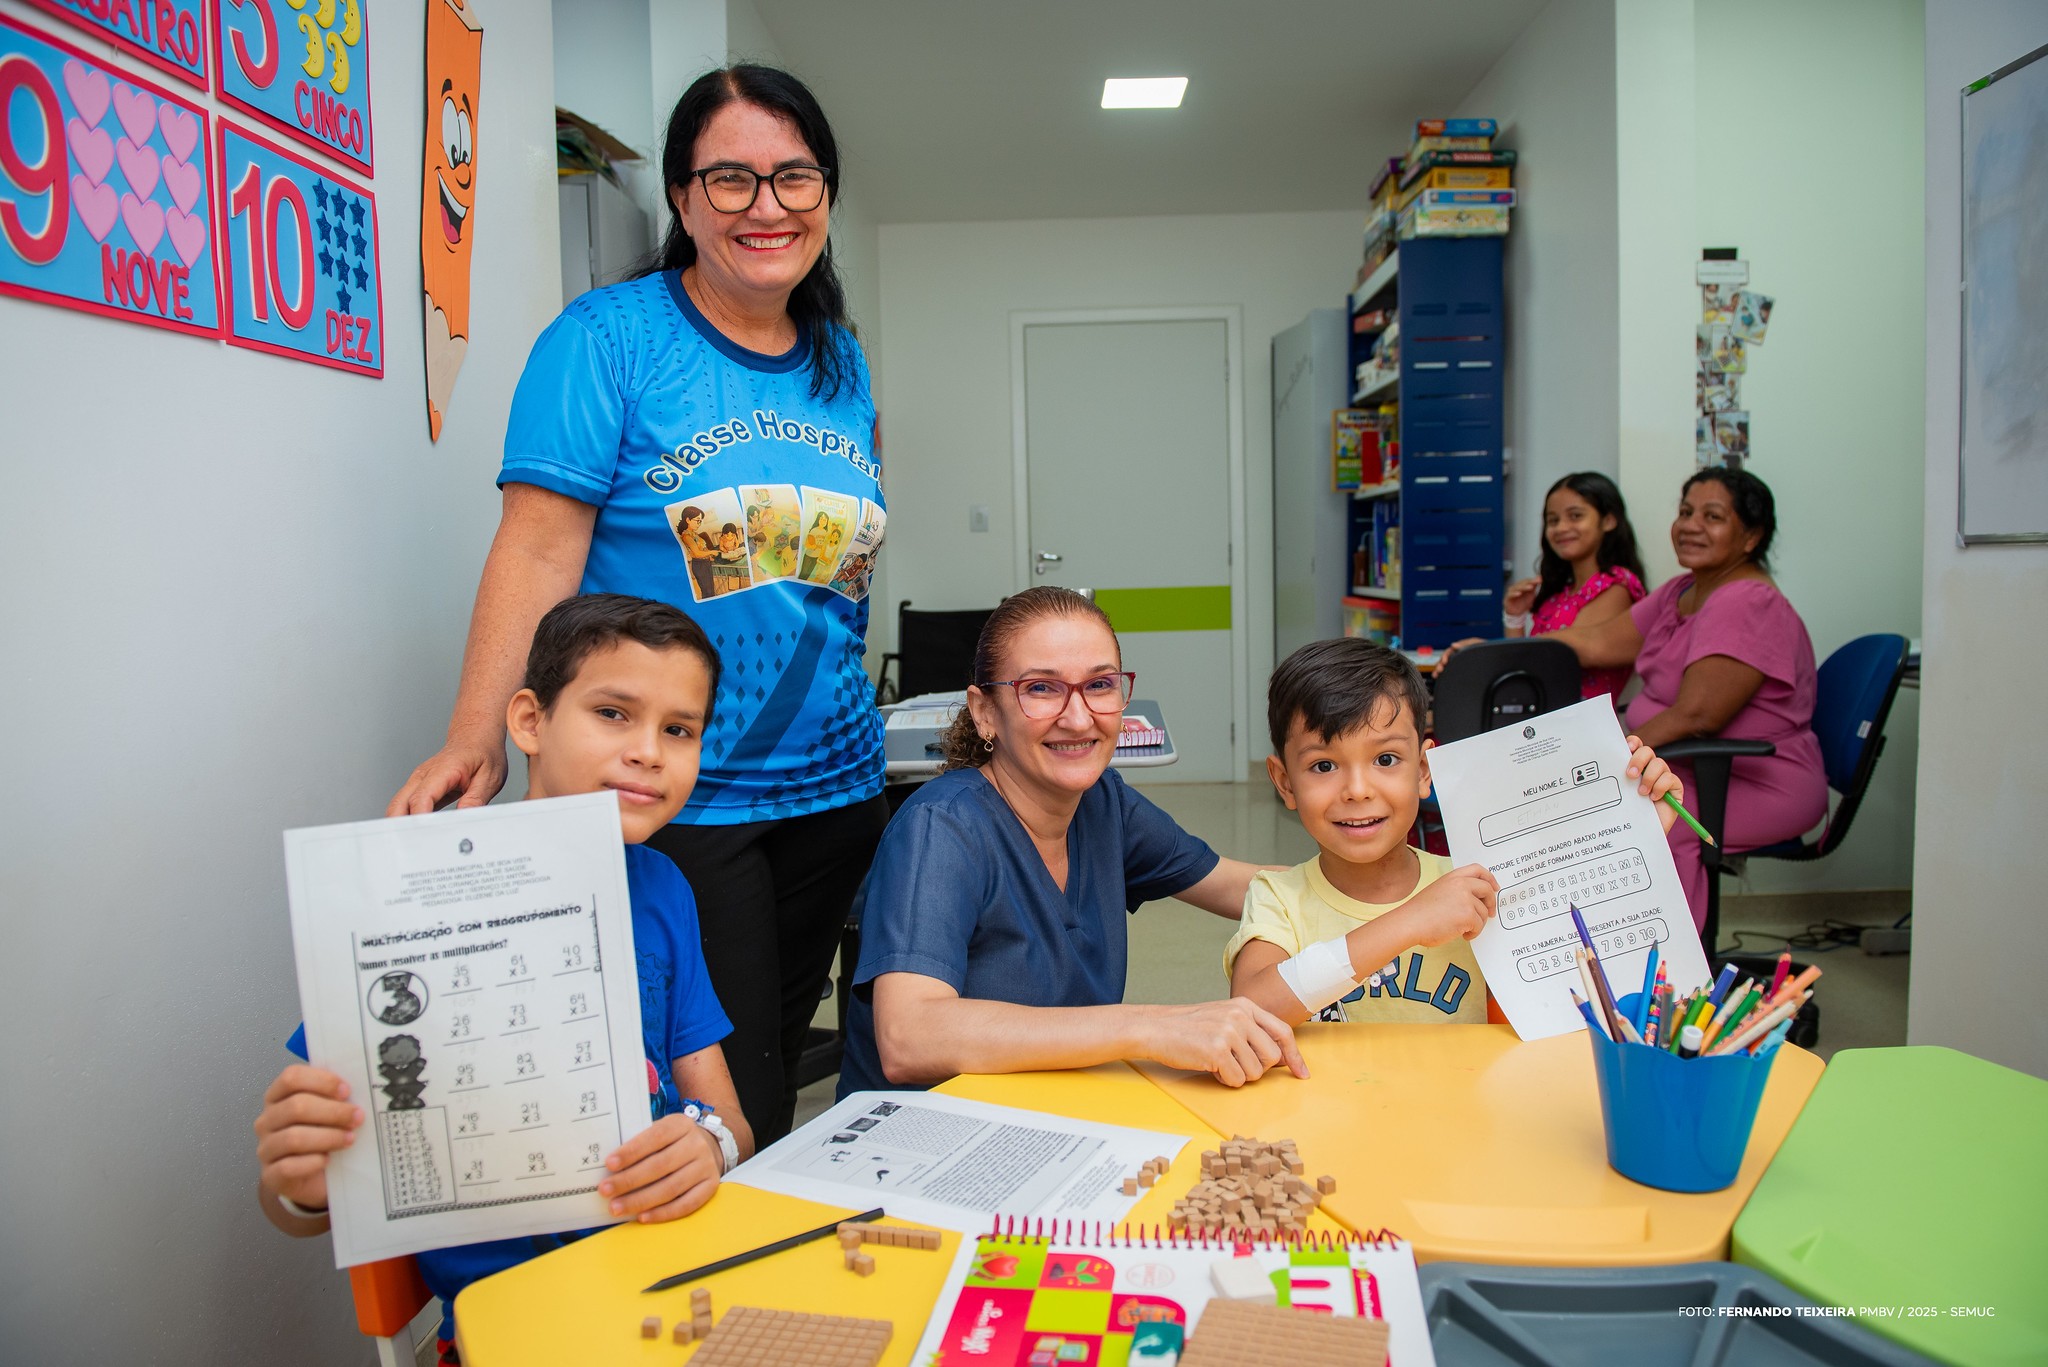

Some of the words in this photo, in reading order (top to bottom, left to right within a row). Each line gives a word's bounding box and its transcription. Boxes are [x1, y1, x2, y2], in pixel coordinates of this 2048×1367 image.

[294, 80, 364, 154] CINCO
[0, 53, 70, 266] 9
[231, 161, 315, 331] 10
[101, 243, 194, 321] NOVE
[325, 309, 374, 363] DEZ
[644, 418, 751, 493] Classe
[1522, 788, 1538, 798] MEU
[1539, 782, 1558, 794] NOME
[1488, 859, 1516, 873] PROCURE
[1520, 853, 1538, 864] PINTE
[1548, 840, 1572, 853] QUADRO
[1573, 833, 1597, 845] ABAIXO
[1598, 826, 1622, 838] APENAS
[1623, 822, 1632, 830] AS
[1513, 867, 1535, 879] LETRAS
[1536, 862, 1546, 871] QUE
[1548, 855, 1574, 866] FORMAM
[1582, 848, 1594, 856] SEU
[1500, 898, 1507, 907] A
[1510, 894, 1516, 903] B
[1519, 891, 1526, 900] C
[1529, 887, 1536, 897] D
[1538, 884, 1546, 894] E
[1548, 881, 1554, 891] F
[1557, 878, 1566, 887] G
[1568, 874, 1577, 885] H
[1579, 872, 1587, 882] I
[1589, 869, 1596, 879] J
[1598, 866, 1607, 876] K
[1609, 864, 1616, 873] L
[1619, 859, 1631, 870] M
[1633, 856, 1643, 866] N
[1507, 911, 1515, 920] O
[1518, 908, 1525, 917] P
[1528, 904, 1537, 915] Q
[1541, 901, 1549, 911] R
[1551, 898, 1558, 907] S
[1560, 895, 1568, 904] T
[1570, 891, 1579, 901] U
[1581, 888, 1590, 898] V
[1593, 884, 1606, 895] W
[1608, 881, 1618, 890] X
[1620, 877, 1628, 886] Y
[1631, 874, 1640, 883] Z
[458, 920, 482, 933] COM
[1511, 946, 1531, 956] PINTE
[1538, 936, 1566, 949] NUMERAL
[1568, 931, 1580, 941] QUE
[1627, 914, 1640, 923] SUA
[562, 944, 580, 956] 40
[1528, 962, 1537, 974] 1
[1540, 959, 1550, 971] 2
[1551, 956, 1561, 967] 3
[1564, 952, 1574, 963] 4
[1601, 940, 1610, 952] 7
[1613, 937, 1624, 948] 8
[1626, 932, 1637, 944] 9
[1639, 926, 1657, 940] 10
[358, 960, 388, 971] Vamos
[392, 954, 426, 968] resolver
[430, 951, 439, 961] as
[511, 954, 524, 966] 61
[454, 965, 469, 978] 35
[570, 992, 586, 1004] 64
[510, 1004, 525, 1016] 73
[452, 1015, 470, 1027] 26
[576, 1042, 591, 1053] 57
[517, 1053, 532, 1064] 82
[457, 1064, 474, 1075] 95
[581, 1092, 596, 1103] 82
[521, 1102, 538, 1114] 24
[462, 1113, 479, 1122] 46
[588, 1144, 600, 1154] 18
[528, 1153, 544, 1162] 99
